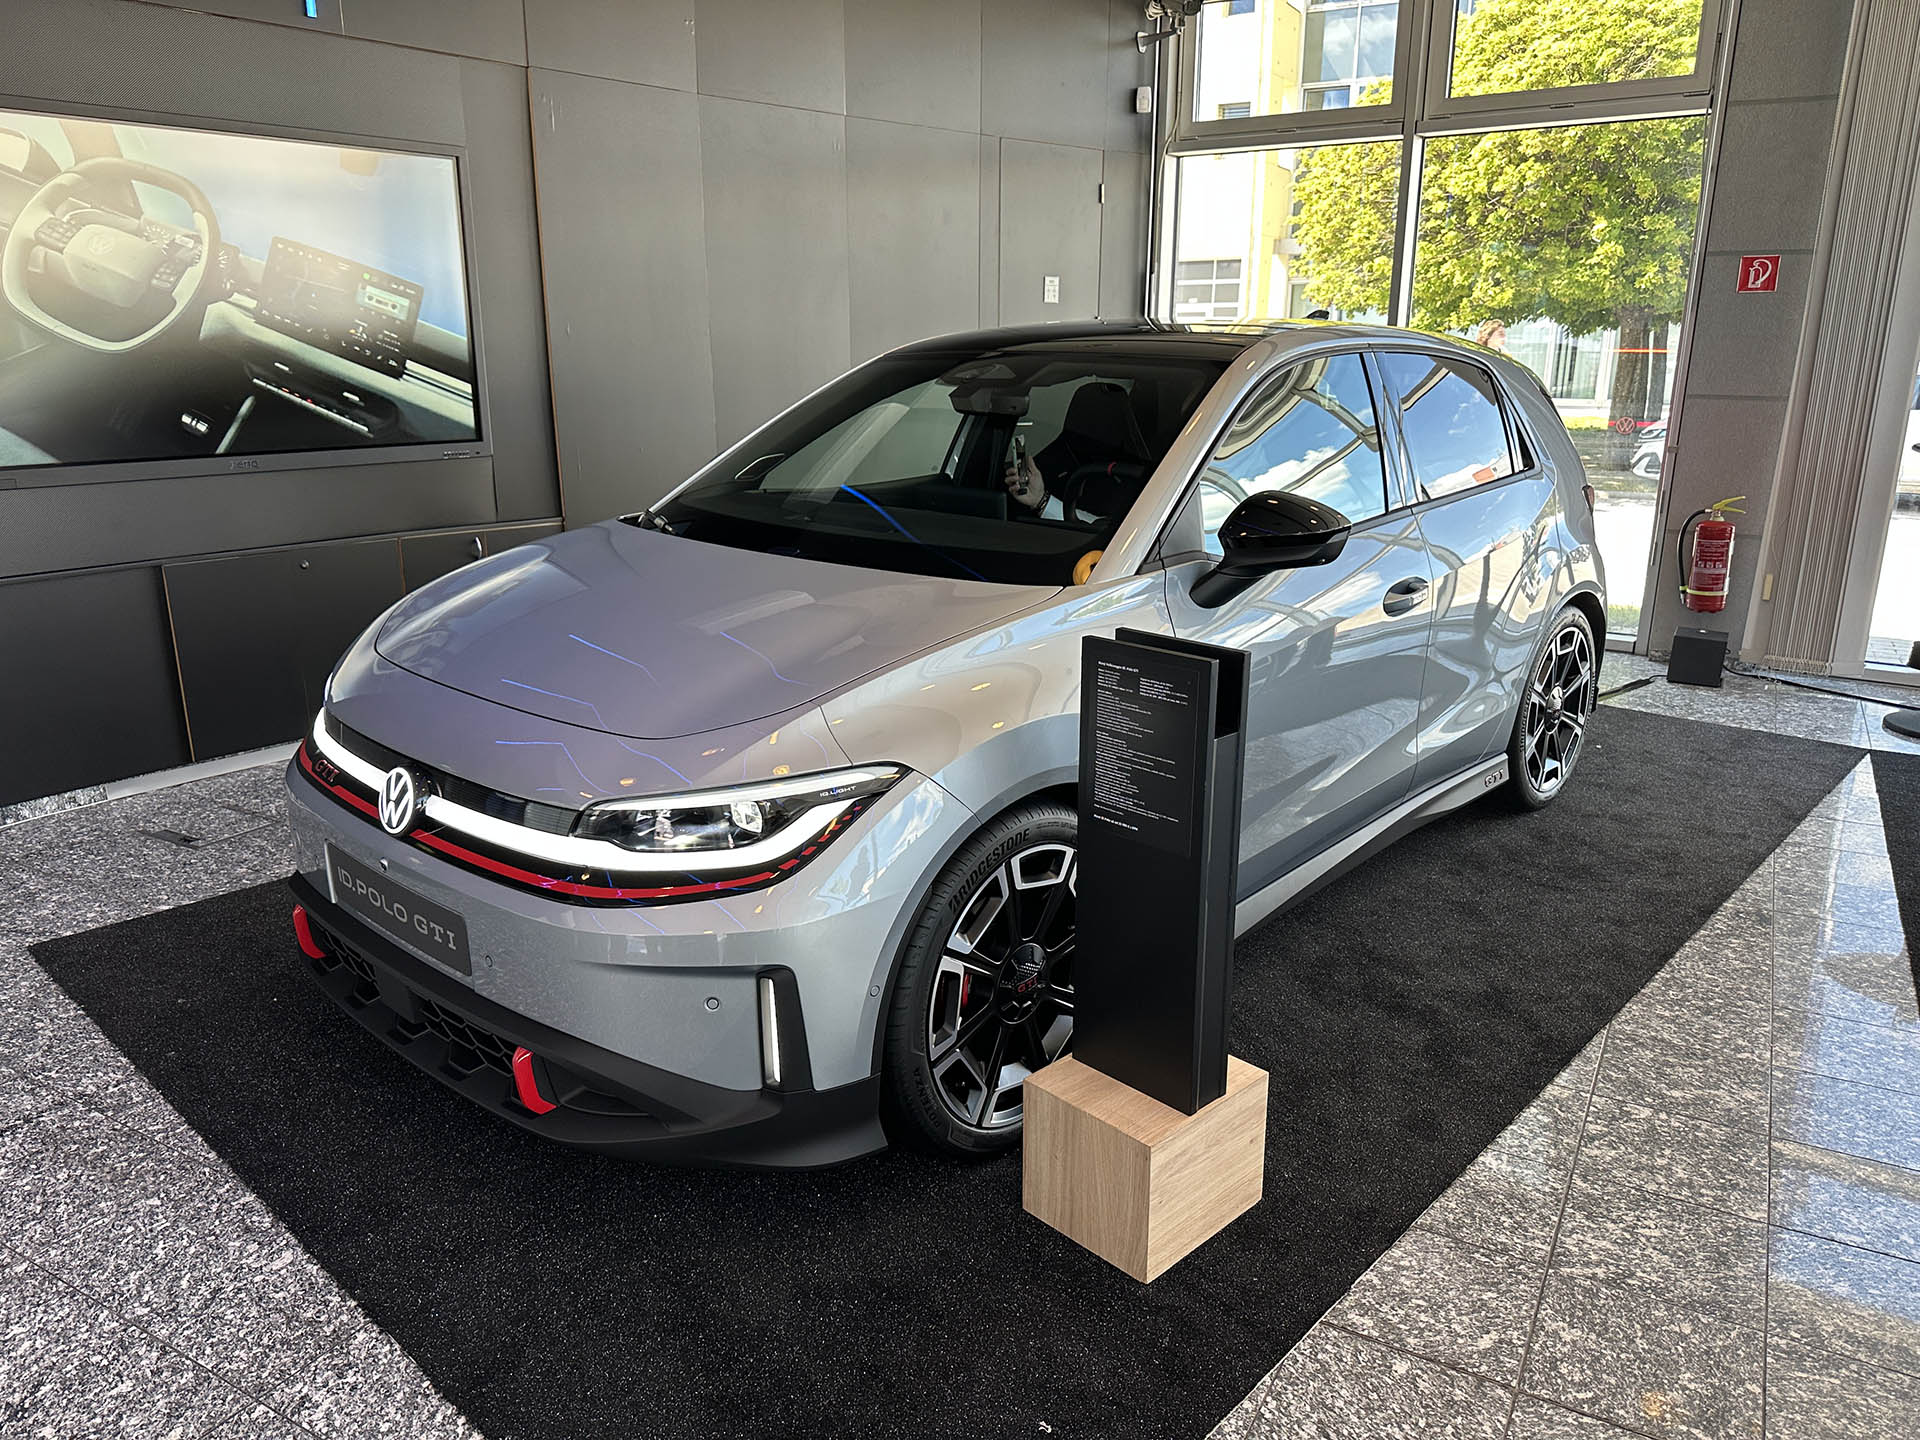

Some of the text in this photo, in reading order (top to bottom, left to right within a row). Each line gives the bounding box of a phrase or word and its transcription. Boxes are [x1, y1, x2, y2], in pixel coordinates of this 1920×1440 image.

[315, 760, 340, 782] GTI
[379, 767, 413, 834] VW
[948, 828, 1030, 915] BRIDGESTONE
[413, 914, 456, 950] GTI
[1017, 977, 1038, 993] GTI
